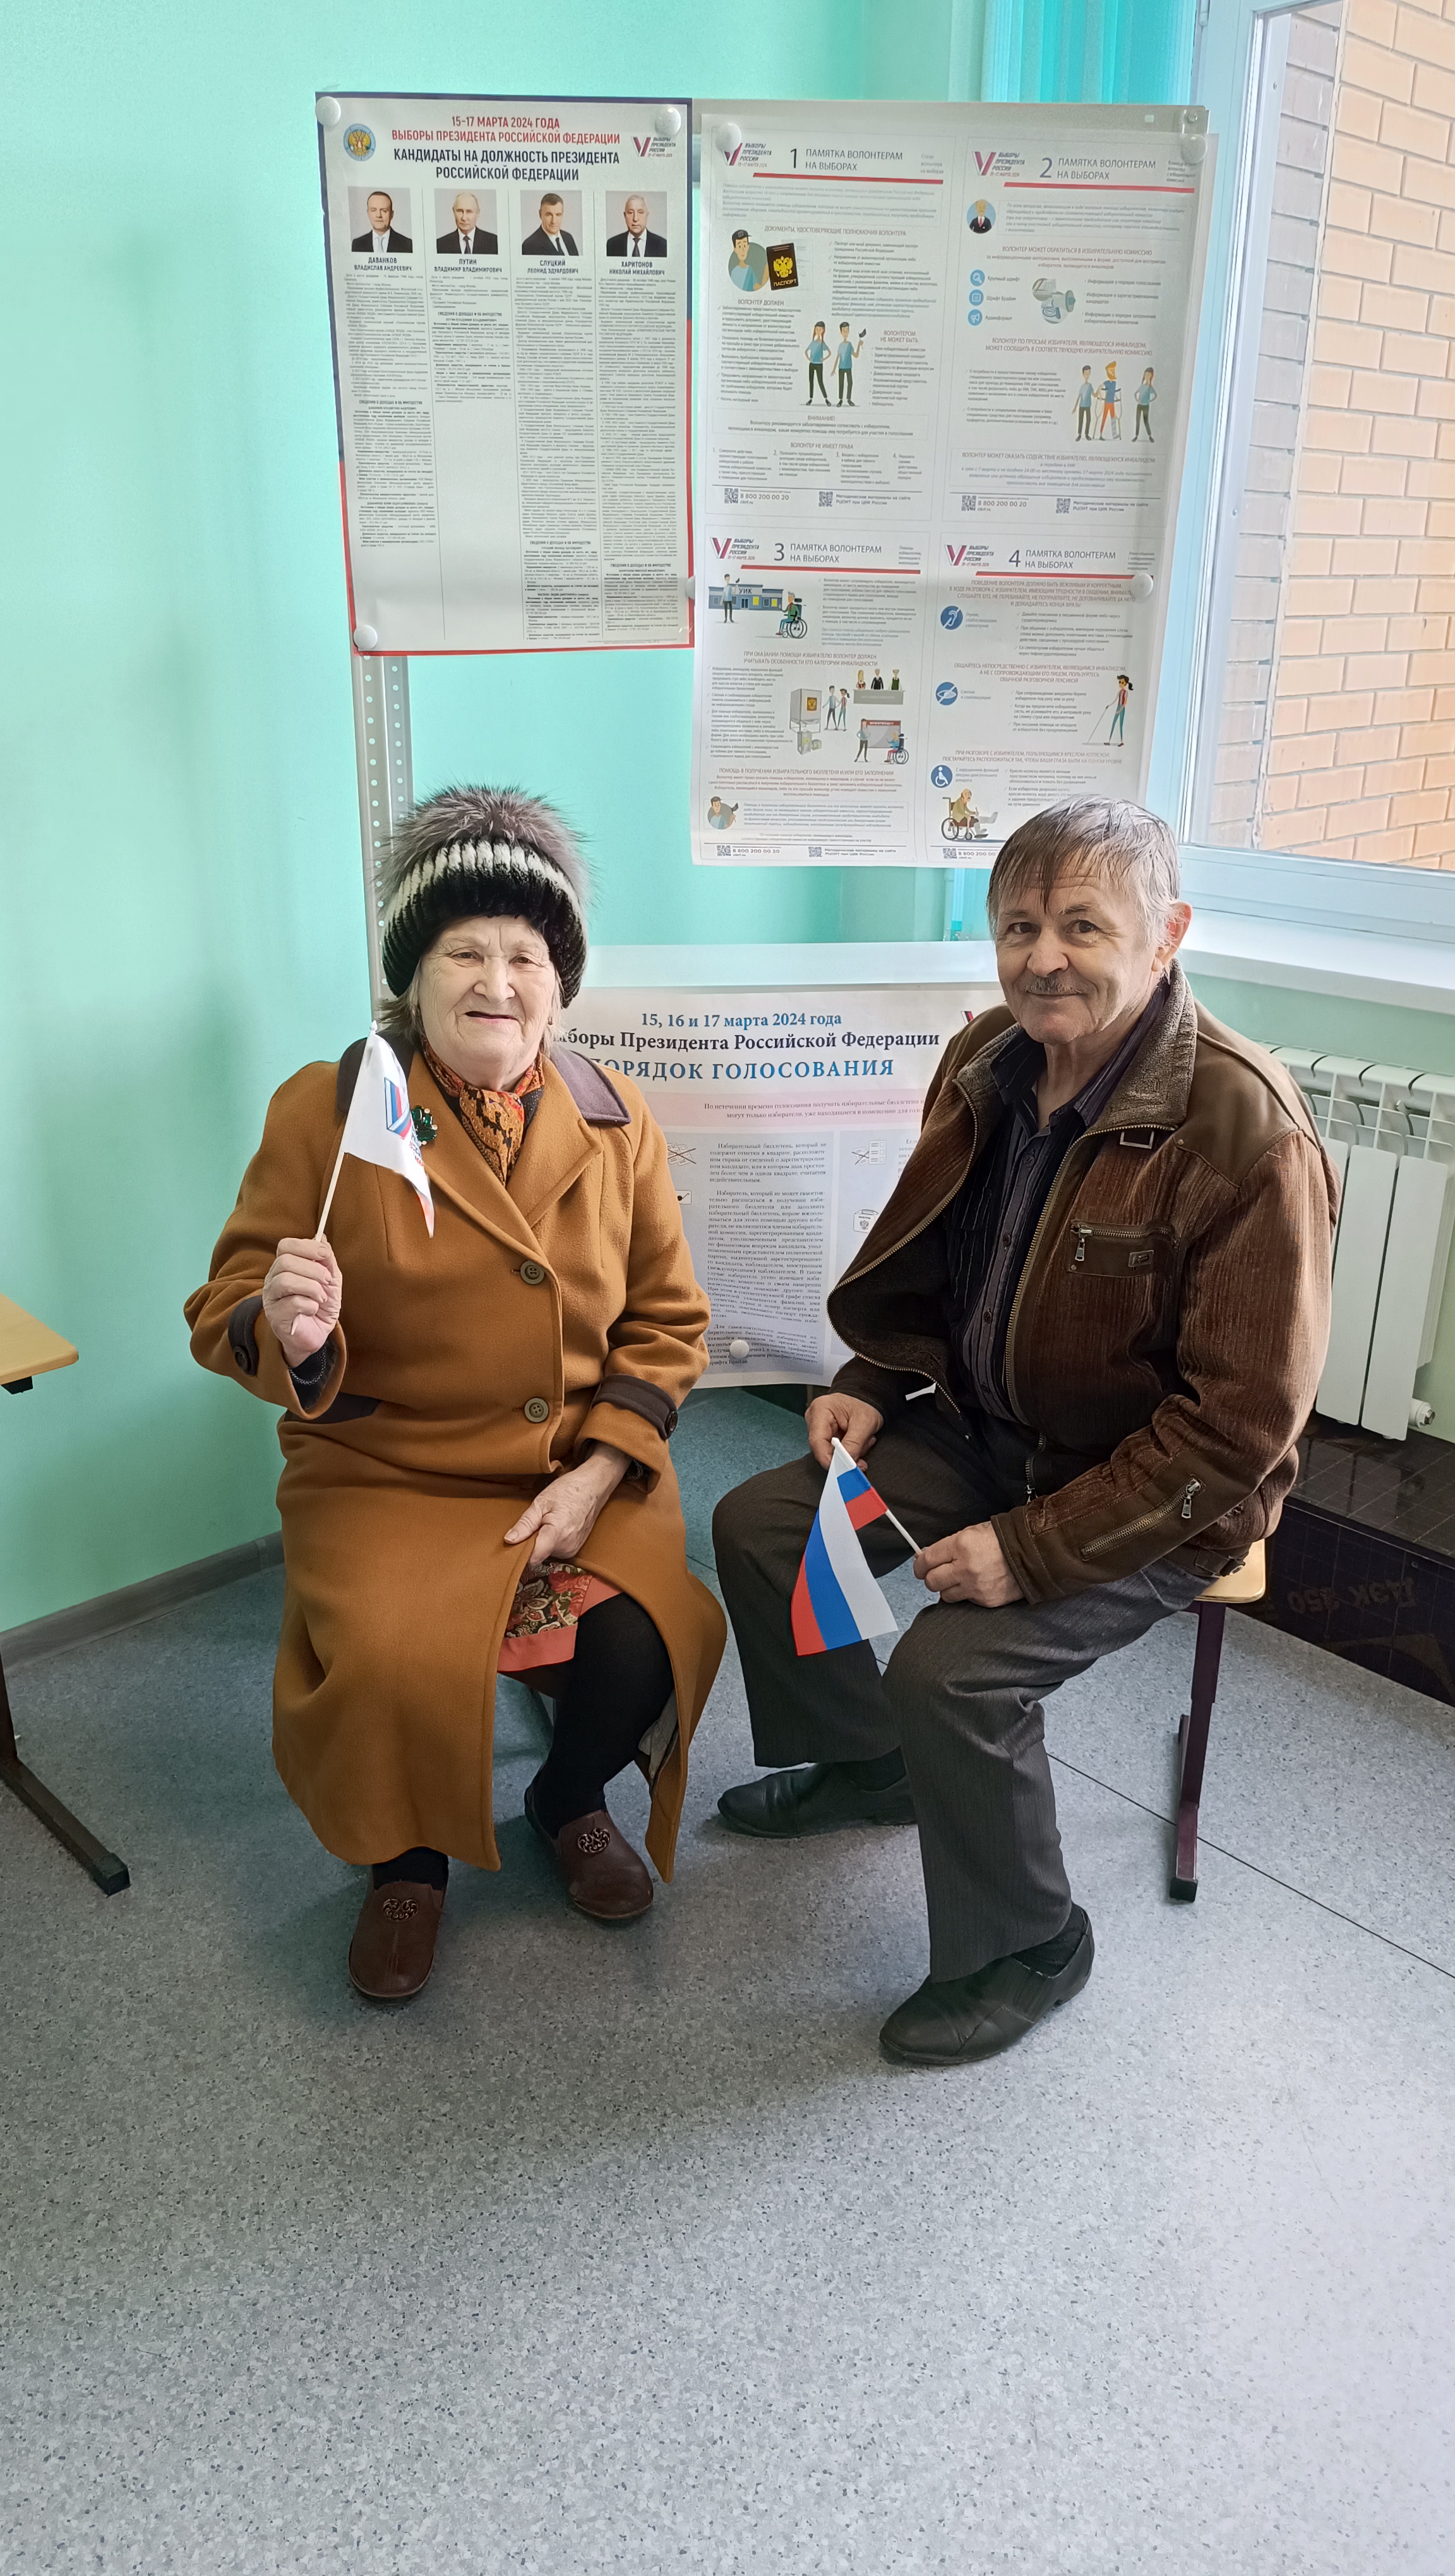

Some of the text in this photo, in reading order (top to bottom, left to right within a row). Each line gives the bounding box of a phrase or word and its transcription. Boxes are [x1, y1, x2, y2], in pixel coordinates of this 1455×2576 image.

[477, 116, 508, 127] МАРТА
[511, 117, 532, 128] 2024
[535, 118, 559, 129] ГОДА
[392, 129, 620, 145] ВЫБОРЫ ПРЕЗИДЕНТА РОССИЙСКОЙ ФЕДЕРАЦИИ
[394, 148, 618, 165] КАНДИДАТЫ НА ДОЛЖНОСТЬ ПРЕЗИДЕНТА
[790, 148, 797, 169] 1
[806, 149, 902, 160] ПАМЯТКА ВОЛОНТЕРАМ
[819, 162, 856, 170] ВЫБОРАХ
[1039, 157, 1052, 178] 2
[1058, 158, 1155, 169] ПАМЯТКА ВОЛОНТЕРАМ
[436, 164, 578, 181] РОССИЙСКОЙ ФЕДЕРАЦИИ
[1070, 171, 1109, 179] ВЫБОРАХ
[774, 278, 797, 287] ПАСПОРТ
[774, 543, 785, 561] 3
[829, 544, 881, 552] ВОЛОНТЕРАМ
[1064, 551, 1115, 559] ВОЛОНТЕРАМ
[1009, 550, 1021, 568] 4
[643, 1013, 841, 1030] 15, 16 и 17 марта 2024 года
[560, 1028, 938, 1051] боры Президента Российской Федерации
[589, 1058, 892, 1080] ОРЯДОК ГОЛОСОВАНИЯ
